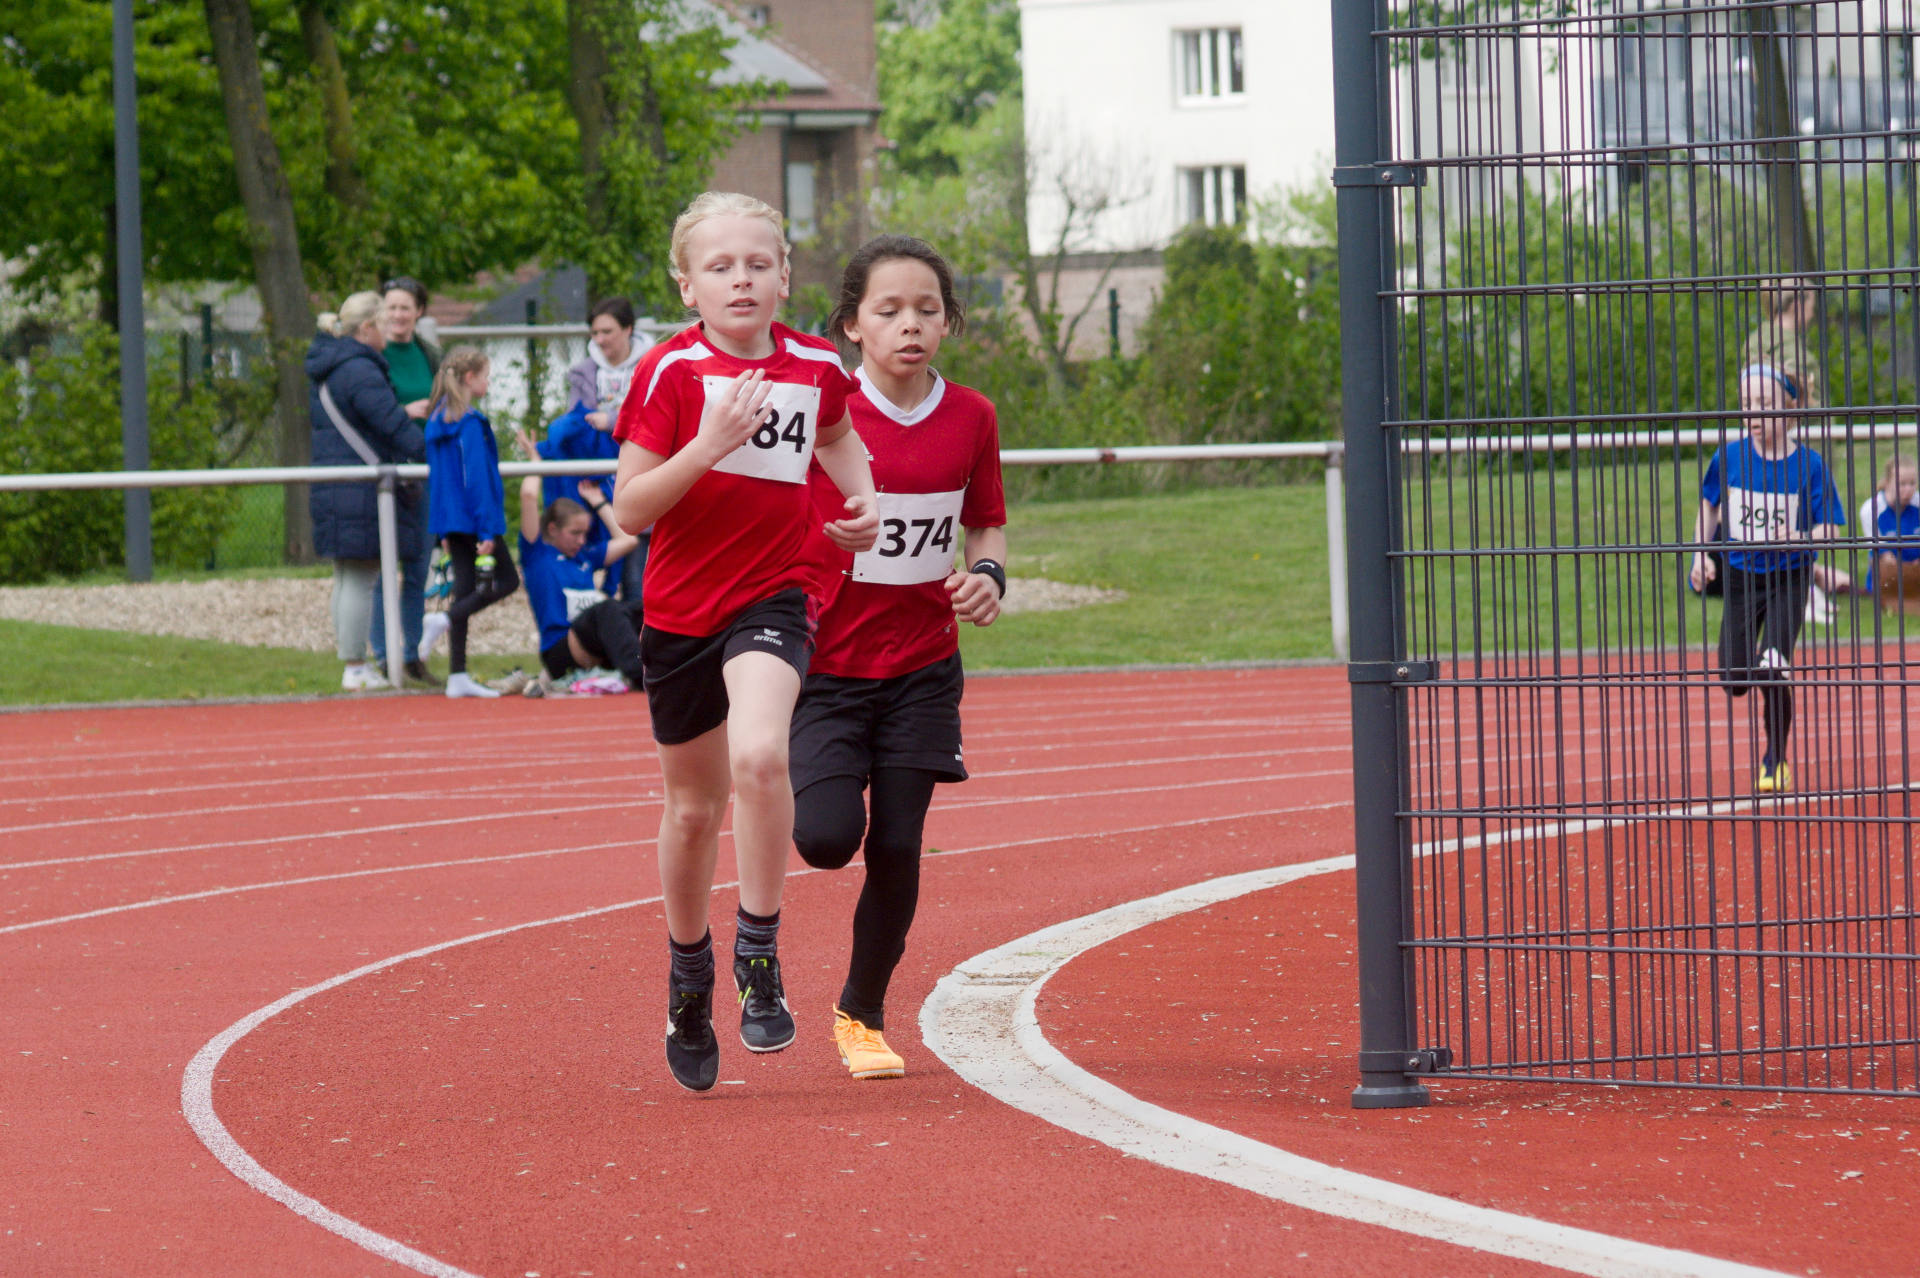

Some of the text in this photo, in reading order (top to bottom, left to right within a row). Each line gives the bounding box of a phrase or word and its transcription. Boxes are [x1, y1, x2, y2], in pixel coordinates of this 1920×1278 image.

[742, 407, 806, 453] 84
[878, 515, 953, 557] 374
[1739, 504, 1786, 530] 295
